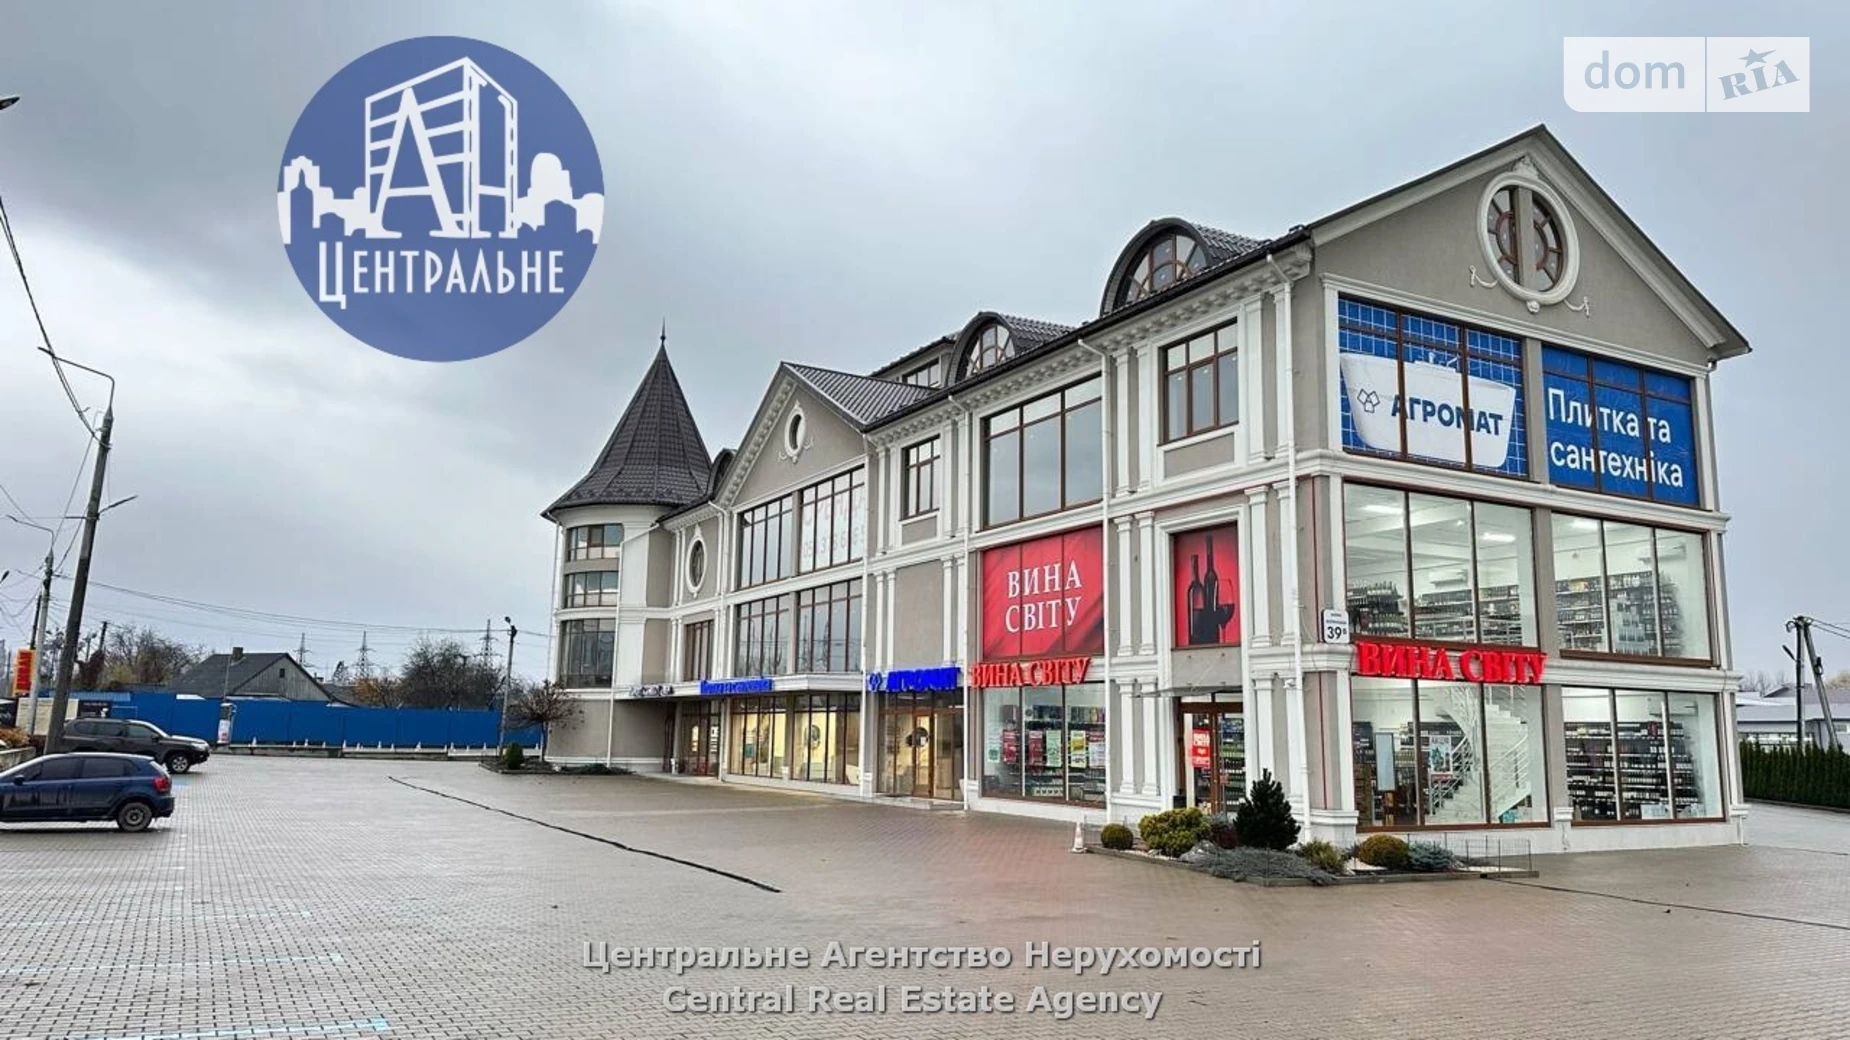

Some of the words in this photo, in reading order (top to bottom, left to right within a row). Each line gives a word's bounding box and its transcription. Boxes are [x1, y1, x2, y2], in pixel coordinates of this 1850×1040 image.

[1391, 394, 1504, 437] АГРОМАТ
[1547, 386, 1640, 438] Плитка
[1647, 415, 1672, 444] та
[1550, 441, 1684, 489] сантехніка
[1007, 560, 1083, 599] ВИНА
[1004, 597, 1082, 634] СВІТУ
[970, 661, 1025, 689] ВИНА
[1027, 656, 1092, 688] СВІТУ
[1356, 641, 1456, 680] ВИНА
[1458, 649, 1548, 685] СВІТУ
